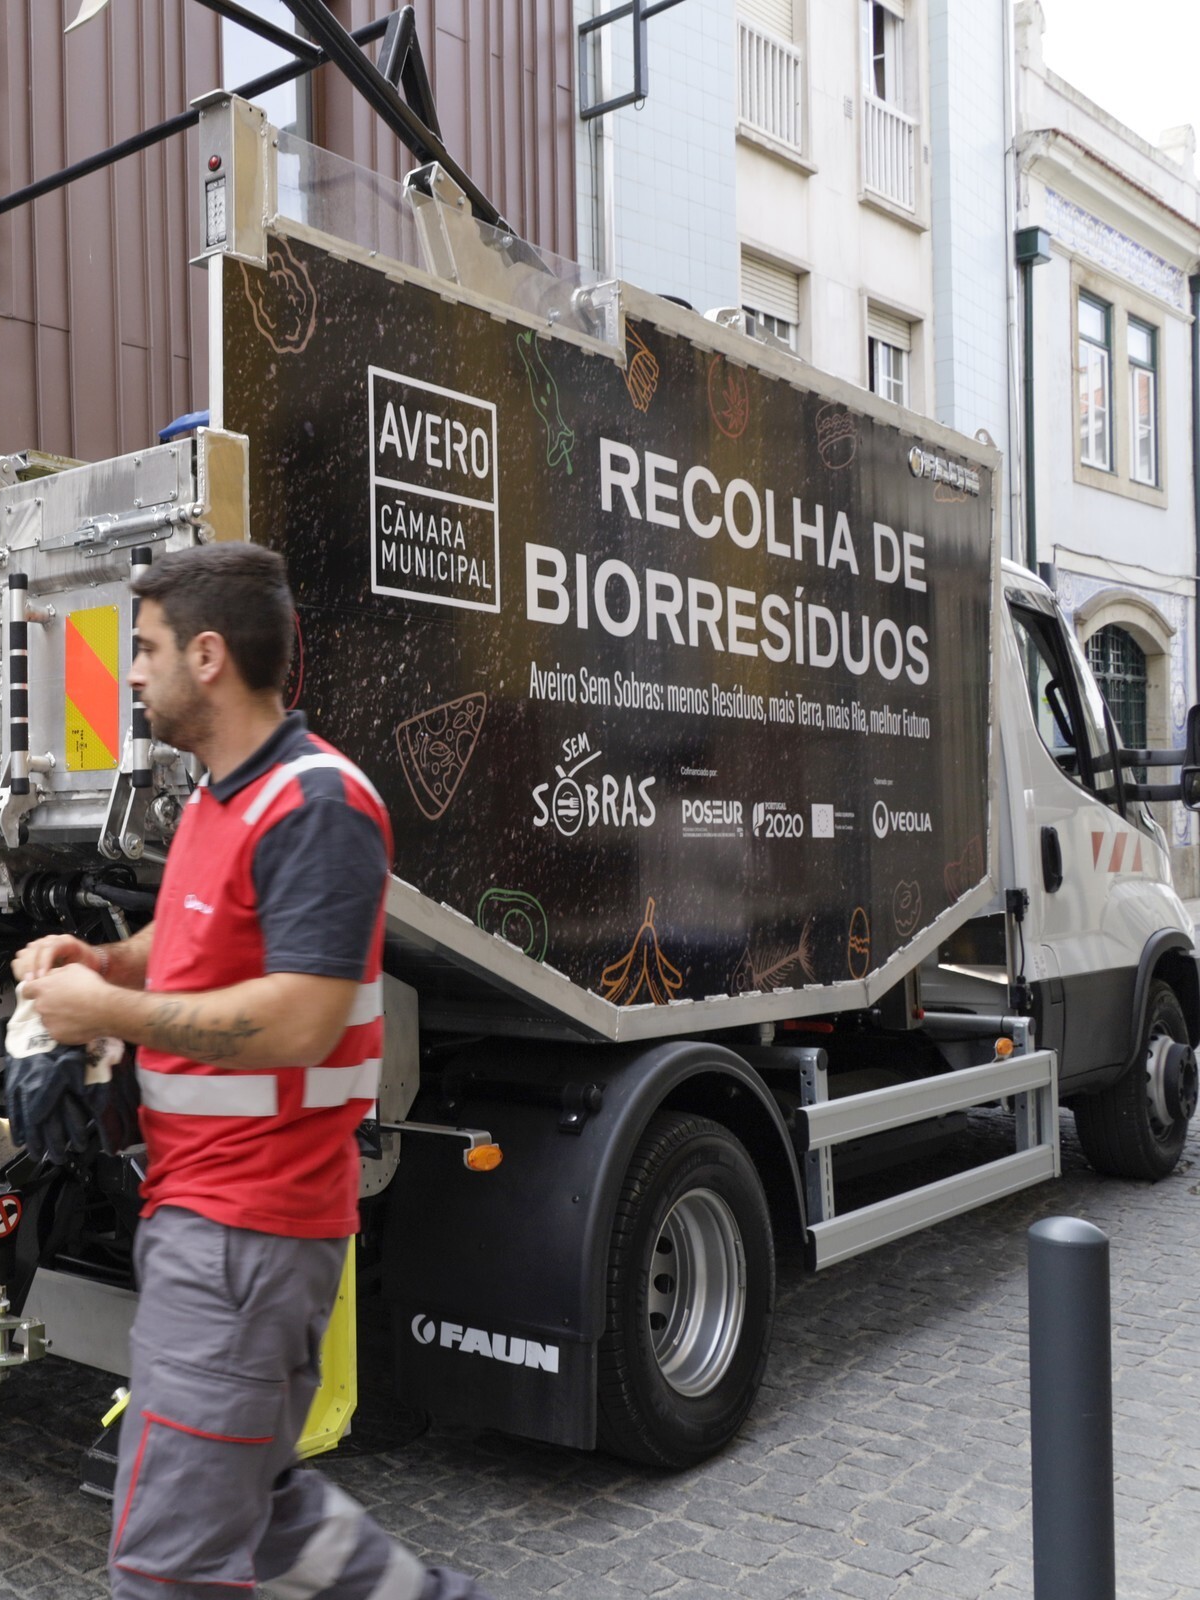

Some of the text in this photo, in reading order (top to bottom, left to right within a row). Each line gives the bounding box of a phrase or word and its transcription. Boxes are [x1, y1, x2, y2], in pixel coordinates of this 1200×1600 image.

[600, 437, 927, 592] RECOLHA DE
[381, 540, 492, 589] MUNICIPAL
[525, 542, 930, 685] BIORRESÍDUOS
[529, 661, 930, 739] Aveiro Sem Sobras: menos Resíduos, mais Terra, mais Ria, melhor Futuro
[562, 731, 591, 762] SEM
[532, 774, 656, 836] SOBRAS
[682, 799, 743, 824] POSEUR
[765, 802, 787, 810] PORTUGAL
[765, 813, 804, 838] 2020
[890, 811, 933, 832] VEOLIA
[440, 1321, 560, 1374] FAUN
